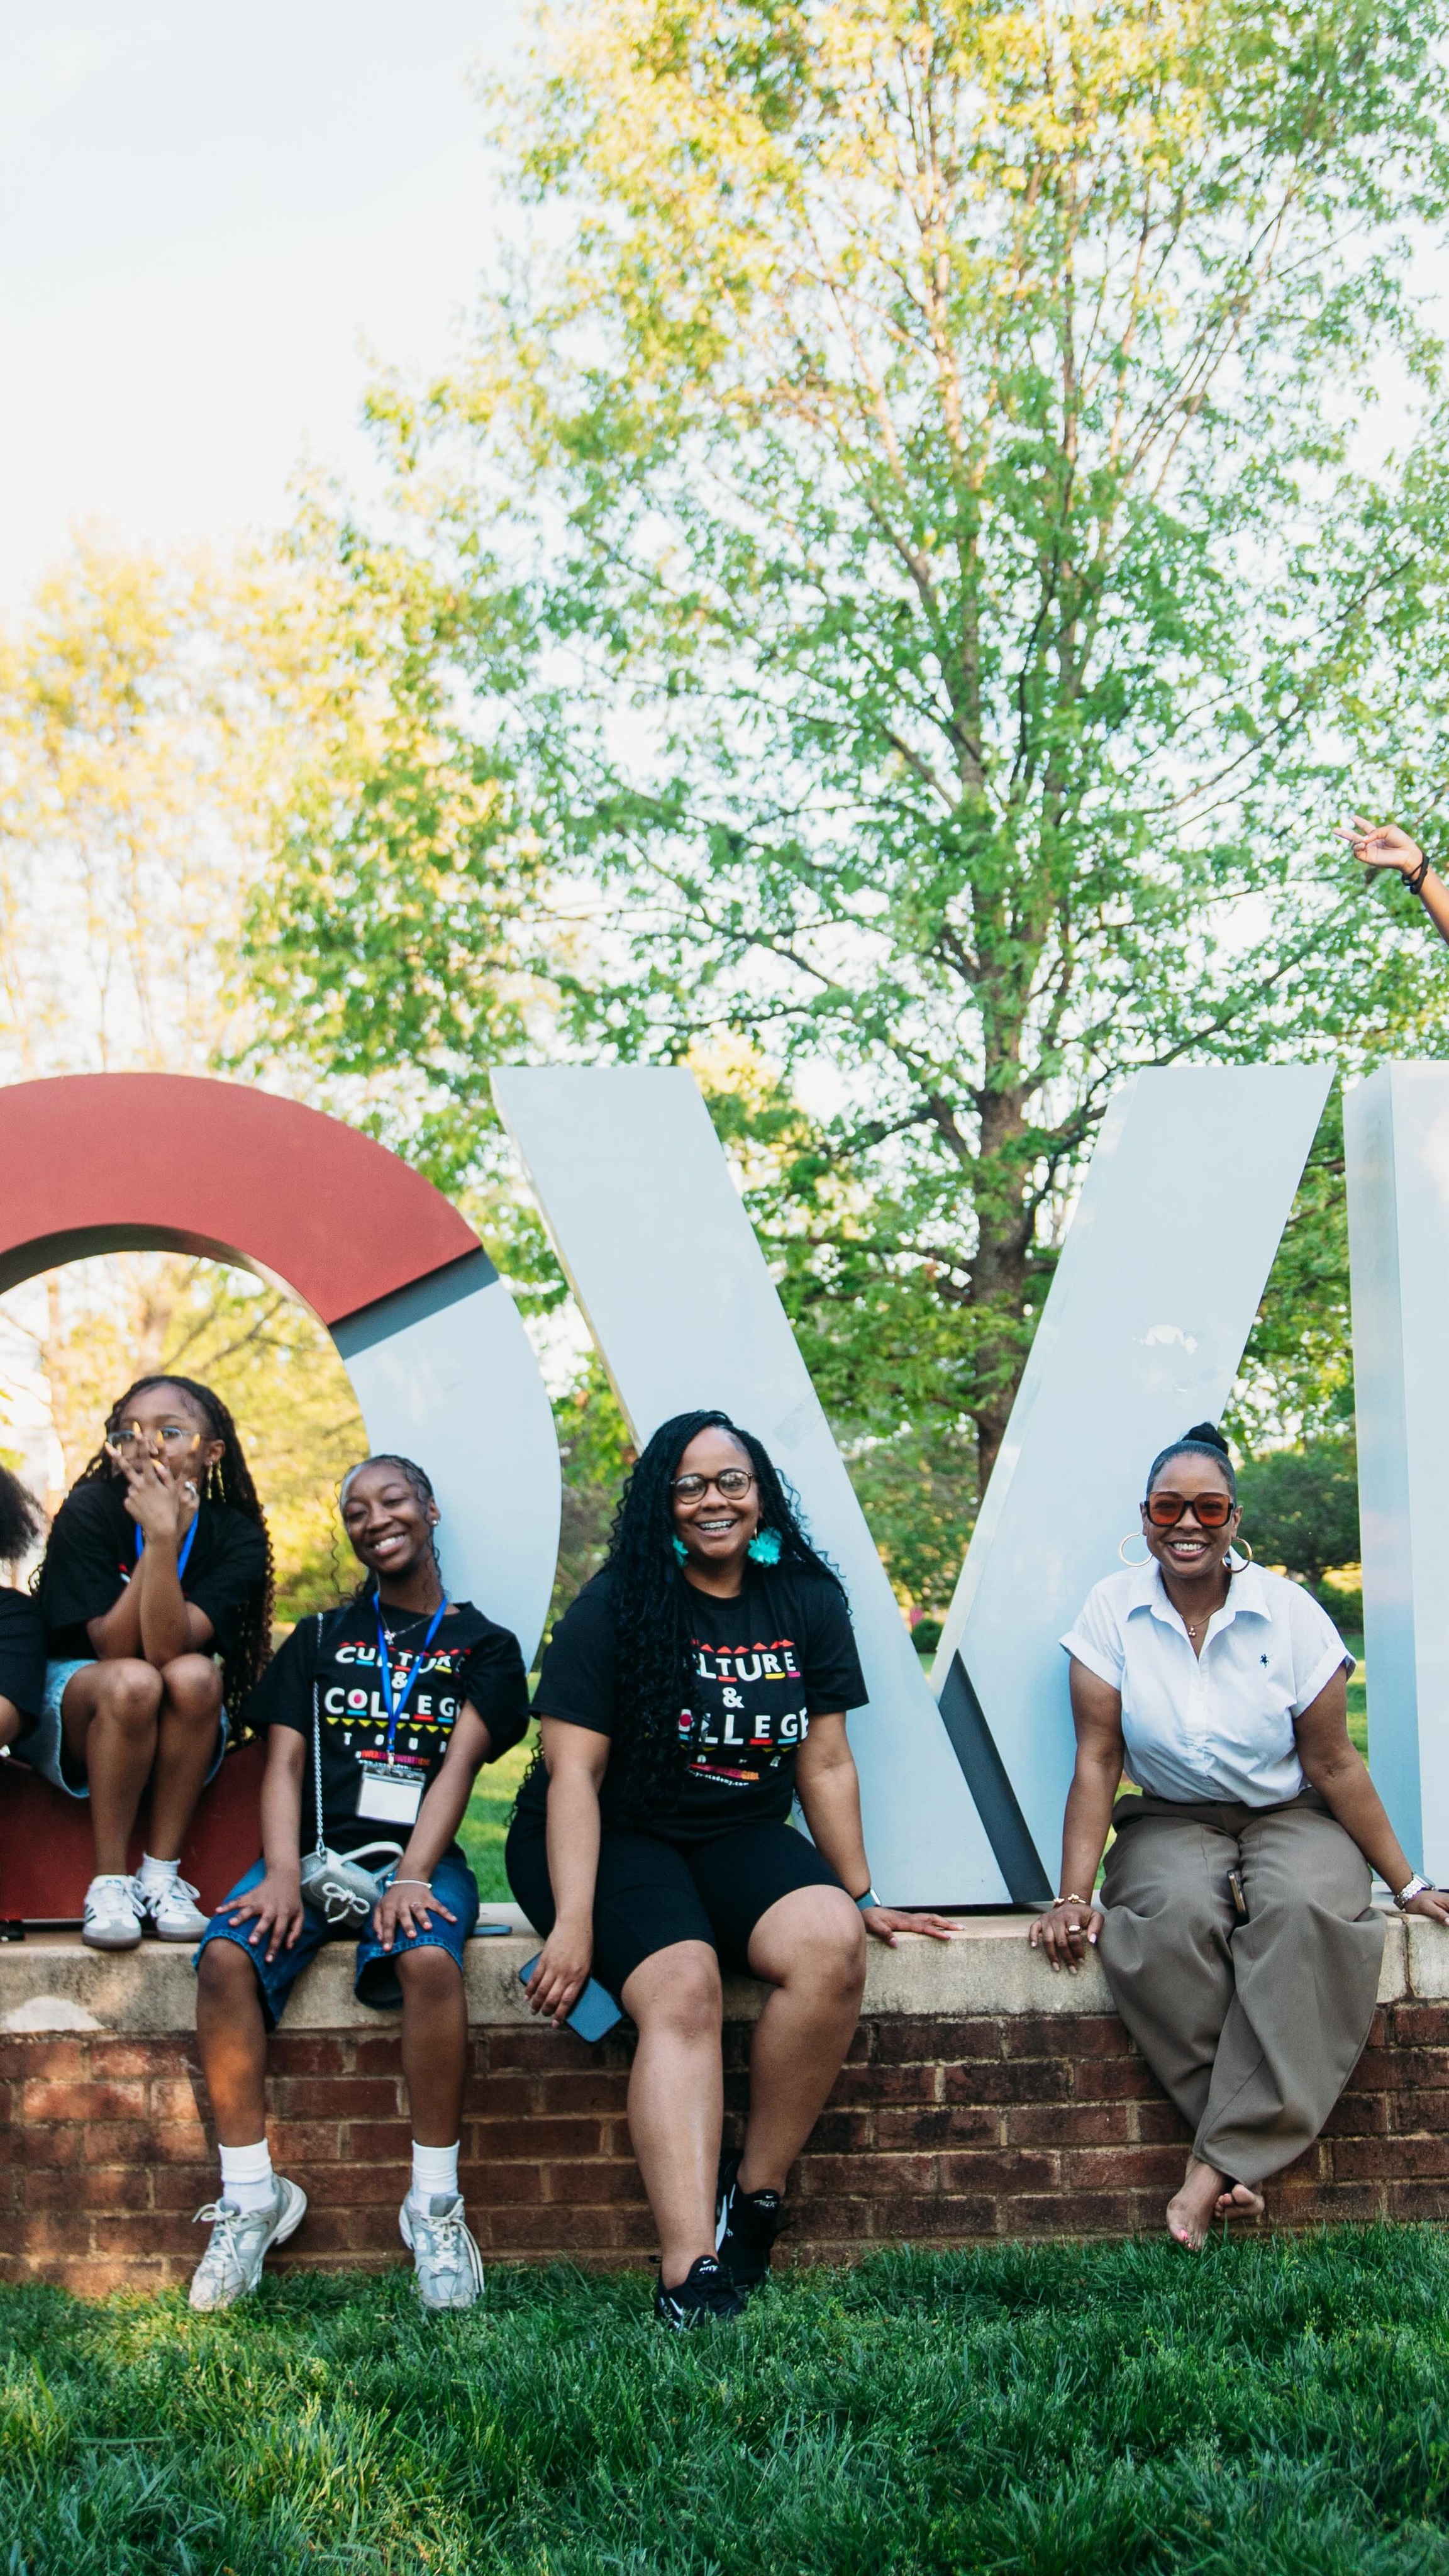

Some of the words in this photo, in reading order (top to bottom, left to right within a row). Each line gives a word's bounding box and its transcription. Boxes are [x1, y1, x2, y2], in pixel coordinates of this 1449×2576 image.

[693, 1652, 797, 1681] LTURE
[325, 1687, 461, 1719] COLLEG
[722, 1687, 745, 1708] &
